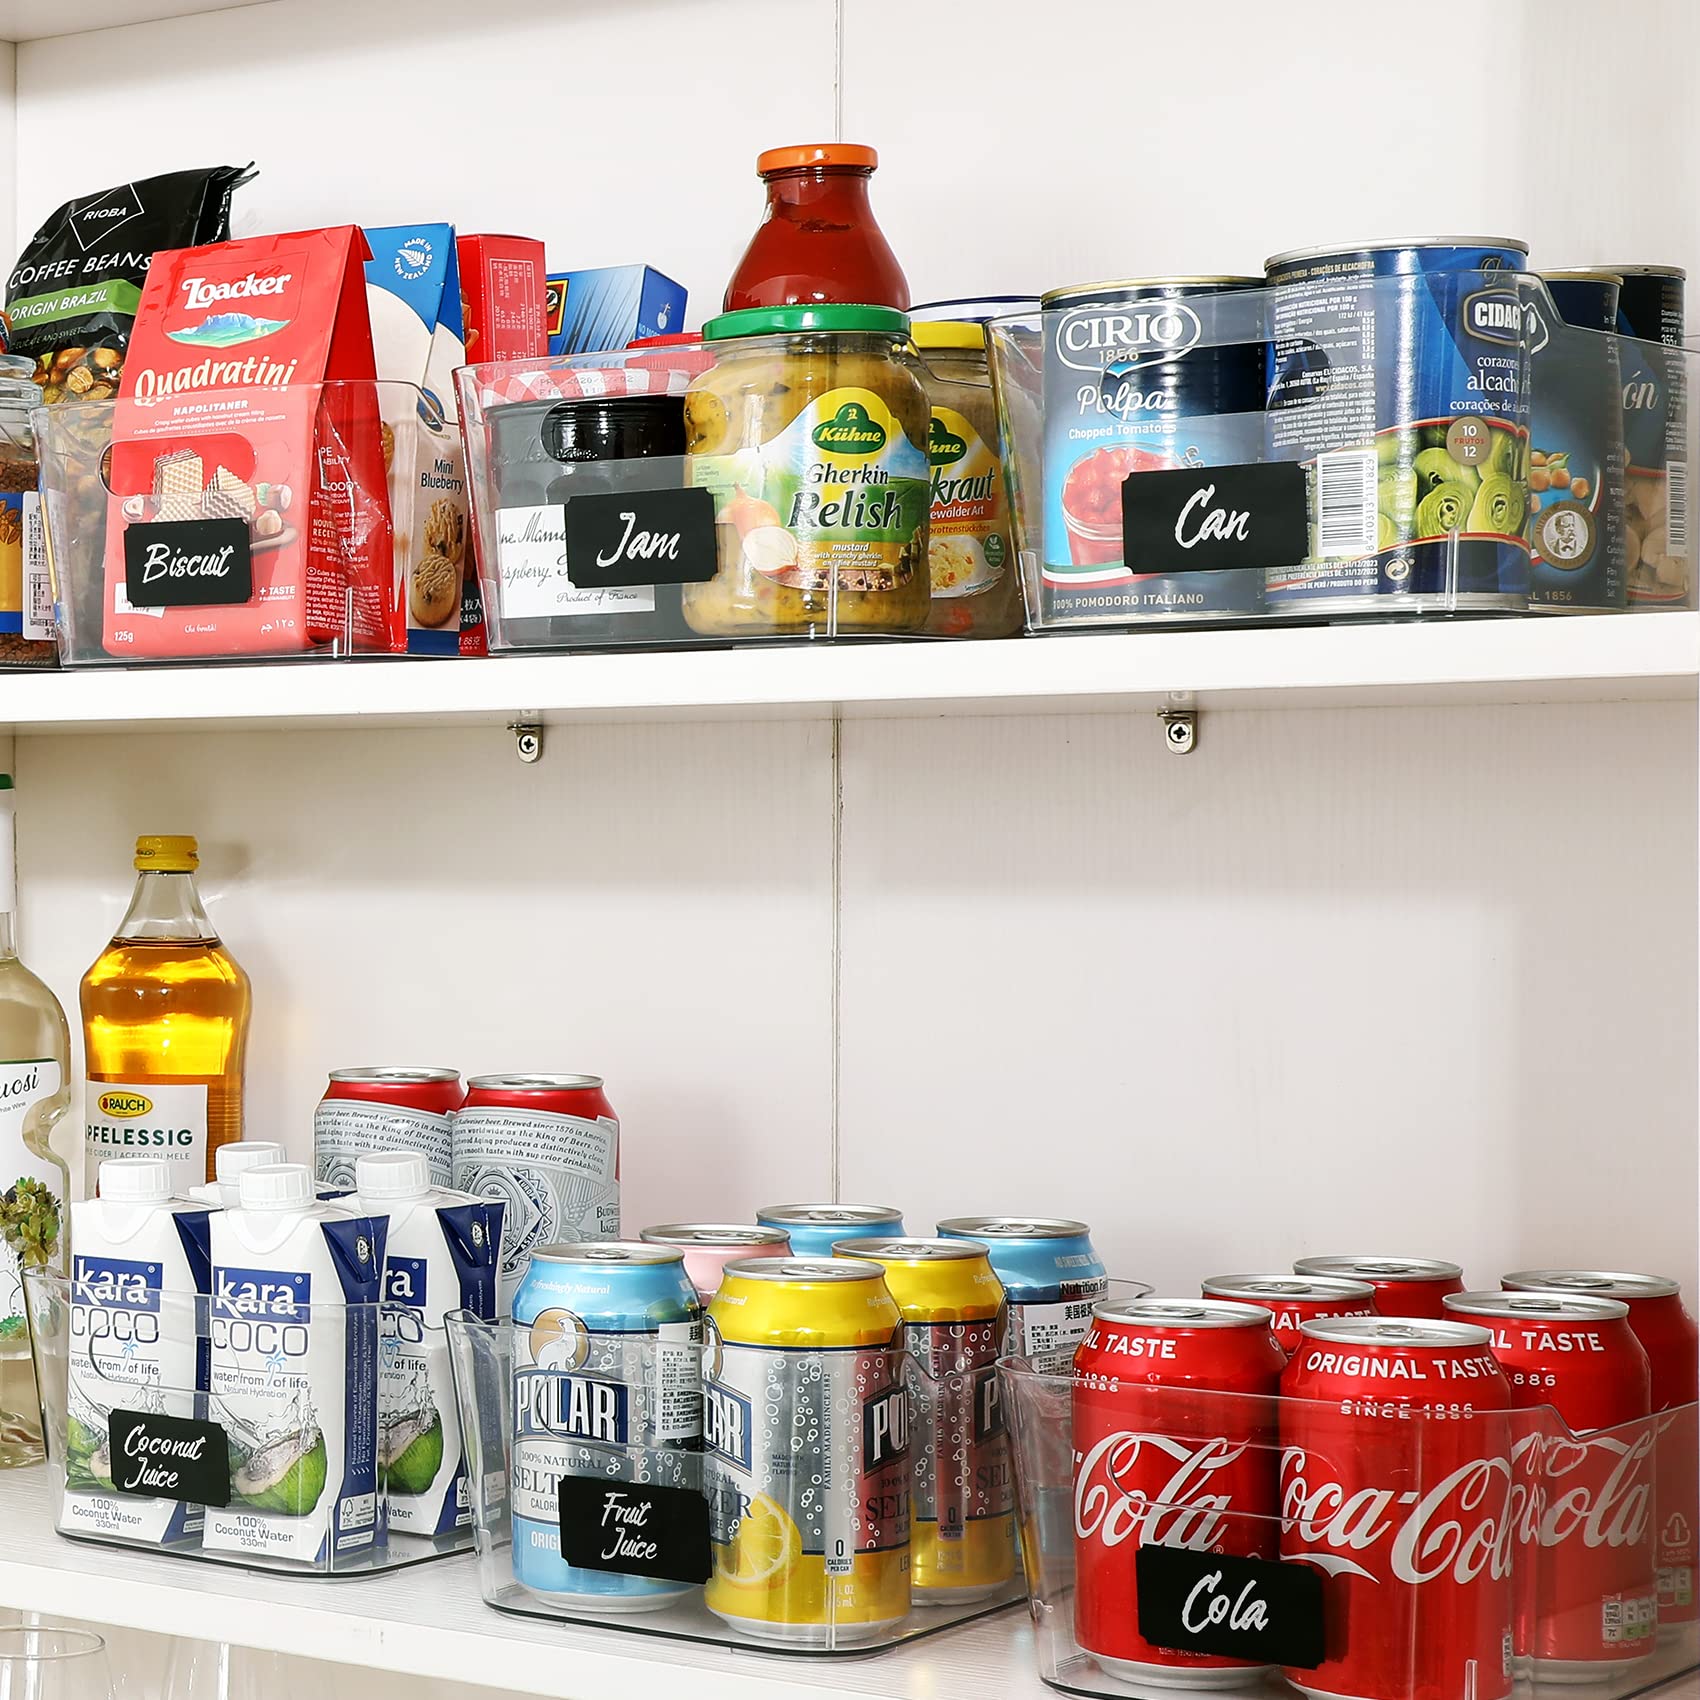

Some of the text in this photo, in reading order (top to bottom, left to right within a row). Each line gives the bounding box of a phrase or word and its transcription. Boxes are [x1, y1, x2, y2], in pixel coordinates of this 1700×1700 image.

[83, 206, 127, 221] RIOBA
[404, 238, 433, 252] MADE IN
[9, 252, 152, 289] COFFEE BEANS
[394, 254, 433, 280] NEW ZEALAND
[181, 272, 292, 310] Loacker
[11, 290, 108, 321] ORIGIN BRAZIL
[1065, 313, 1183, 352] CIRIO
[1099, 347, 1140, 364] 1856
[135, 356, 298, 407] Quadratini
[1623, 370, 1659, 410] ón
[173, 400, 249, 416] NAPOLITANER
[1077, 382, 1170, 421] Polpa
[1450, 399, 1500, 413] corações
[818, 427, 881, 443] Kühne
[1068, 426, 1113, 441] Chopped
[1462, 425, 1477, 437] 10
[930, 440, 961, 454] hne
[1463, 446, 1477, 457] 12
[434, 459, 454, 473] Mini
[806, 463, 889, 484] Gherkin
[421, 471, 464, 495] Blueberry
[930, 466, 995, 507] kraut
[788, 490, 903, 530] Relish
[930, 505, 970, 519] ewälder
[1175, 484, 1251, 548] Can
[500, 532, 516, 545] ne
[596, 512, 681, 568] Jam
[832, 543, 870, 552] mustard
[142, 542, 235, 584] Biscuit
[502, 559, 551, 588] spberry
[268, 586, 296, 595] TASTE
[556, 591, 592, 603] Product
[595, 589, 604, 606] of
[1545, 591, 1572, 601] 1856
[1076, 595, 1139, 607] POMODORO
[1143, 593, 1204, 605] ITALIANO
[114, 631, 134, 643] 125g
[0, 1066, 39, 1099] uosi
[109, 1098, 145, 1112] RAUCH
[366, 1122, 379, 1130] the
[381, 1124, 401, 1136] King
[404, 1129, 414, 1137] of
[502, 1119, 532, 1128] Brewed
[86, 1124, 193, 1146] PFELESSIG
[386, 1134, 434, 1152] distinctively
[495, 1138, 530, 1148] produces
[519, 1130, 533, 1138] the
[535, 1132, 556, 1143] King
[559, 1136, 569, 1144] of
[167, 1152, 191, 1161] MELE
[521, 1231, 536, 1250] ASIA
[76, 1258, 149, 1307] kara
[385, 1276, 414, 1296] ra
[575, 1283, 612, 1295] Natural
[1061, 1279, 1098, 1296] Nutrition
[217, 1270, 299, 1319] kara
[1083, 1329, 1098, 1350] AL
[1106, 1333, 1177, 1359] TASTE
[1521, 1332, 1604, 1352] TASTE
[98, 1358, 159, 1376] from of life
[394, 1359, 426, 1371] of life
[1306, 1351, 1498, 1379] ORIGINAL TASTE
[214, 1371, 309, 1390] water from of life
[1513, 1373, 1556, 1386] 886
[516, 1375, 617, 1444] POLAR
[705, 1389, 745, 1464] LAR
[124, 1424, 206, 1461] Coconut
[544, 1455, 605, 1470] NATURAL
[124, 1456, 179, 1489] Juice
[514, 1465, 561, 1496] SELT
[976, 1463, 1010, 1491] SEL
[90, 1498, 119, 1512] 100%
[600, 1492, 652, 1527] Fruit
[72, 1505, 142, 1526] Coconut Water
[235, 1516, 267, 1529] 100%
[947, 1506, 957, 1523] 0
[96, 1519, 120, 1531] 330ml
[215, 1523, 295, 1543] Coconut Water
[240, 1537, 267, 1549] 330ml
[601, 1527, 659, 1560] Juice
[836, 1539, 844, 1558] 0
[827, 1558, 852, 1566] CALORIES
[830, 1565, 839, 1573] PER
[1182, 1570, 1269, 1634] Cola
